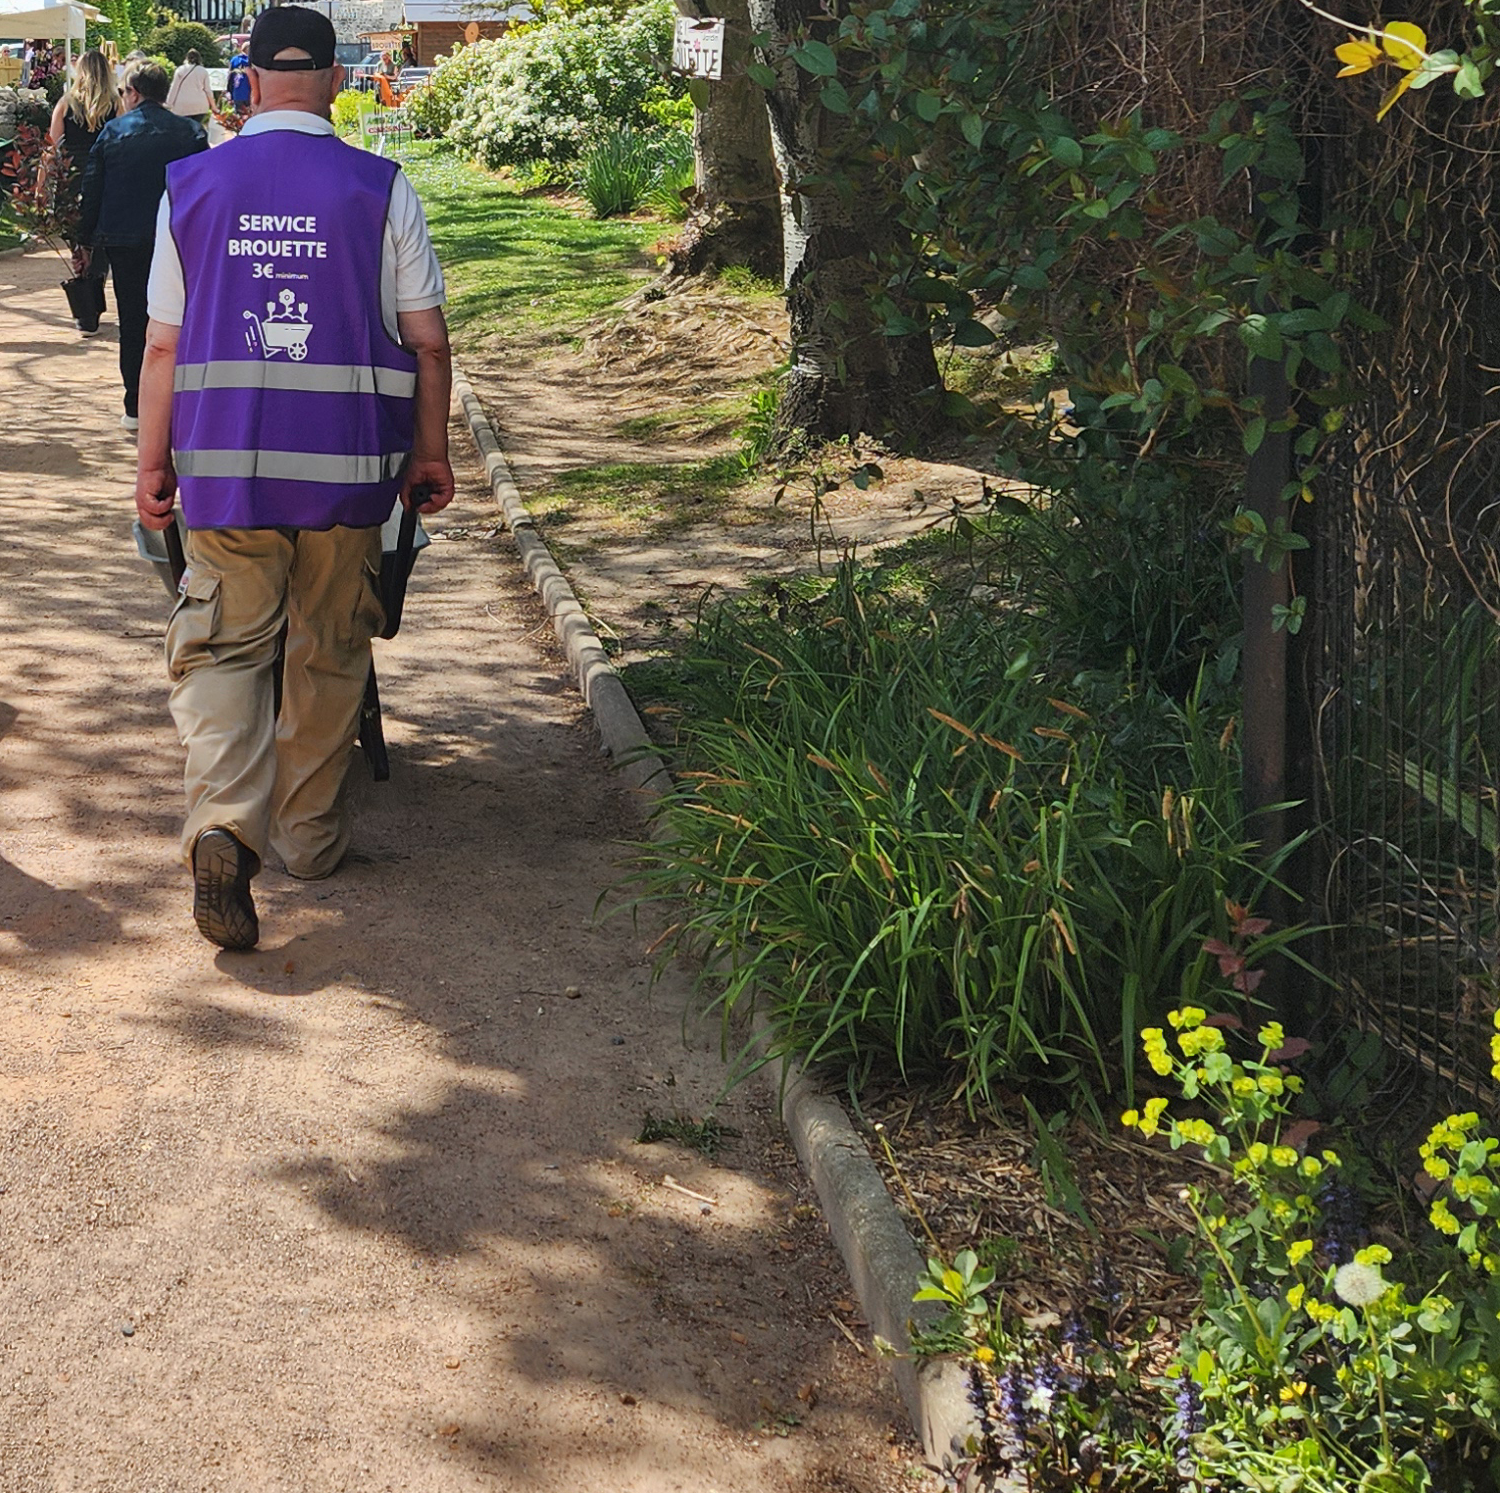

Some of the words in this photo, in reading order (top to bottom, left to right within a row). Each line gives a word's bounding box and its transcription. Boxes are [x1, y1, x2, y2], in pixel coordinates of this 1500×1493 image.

[239, 214, 316, 233] SERVICE
[228, 239, 327, 258] BROUETTE
[252, 263, 274, 279] 3€
[275, 272, 309, 280] minimum
